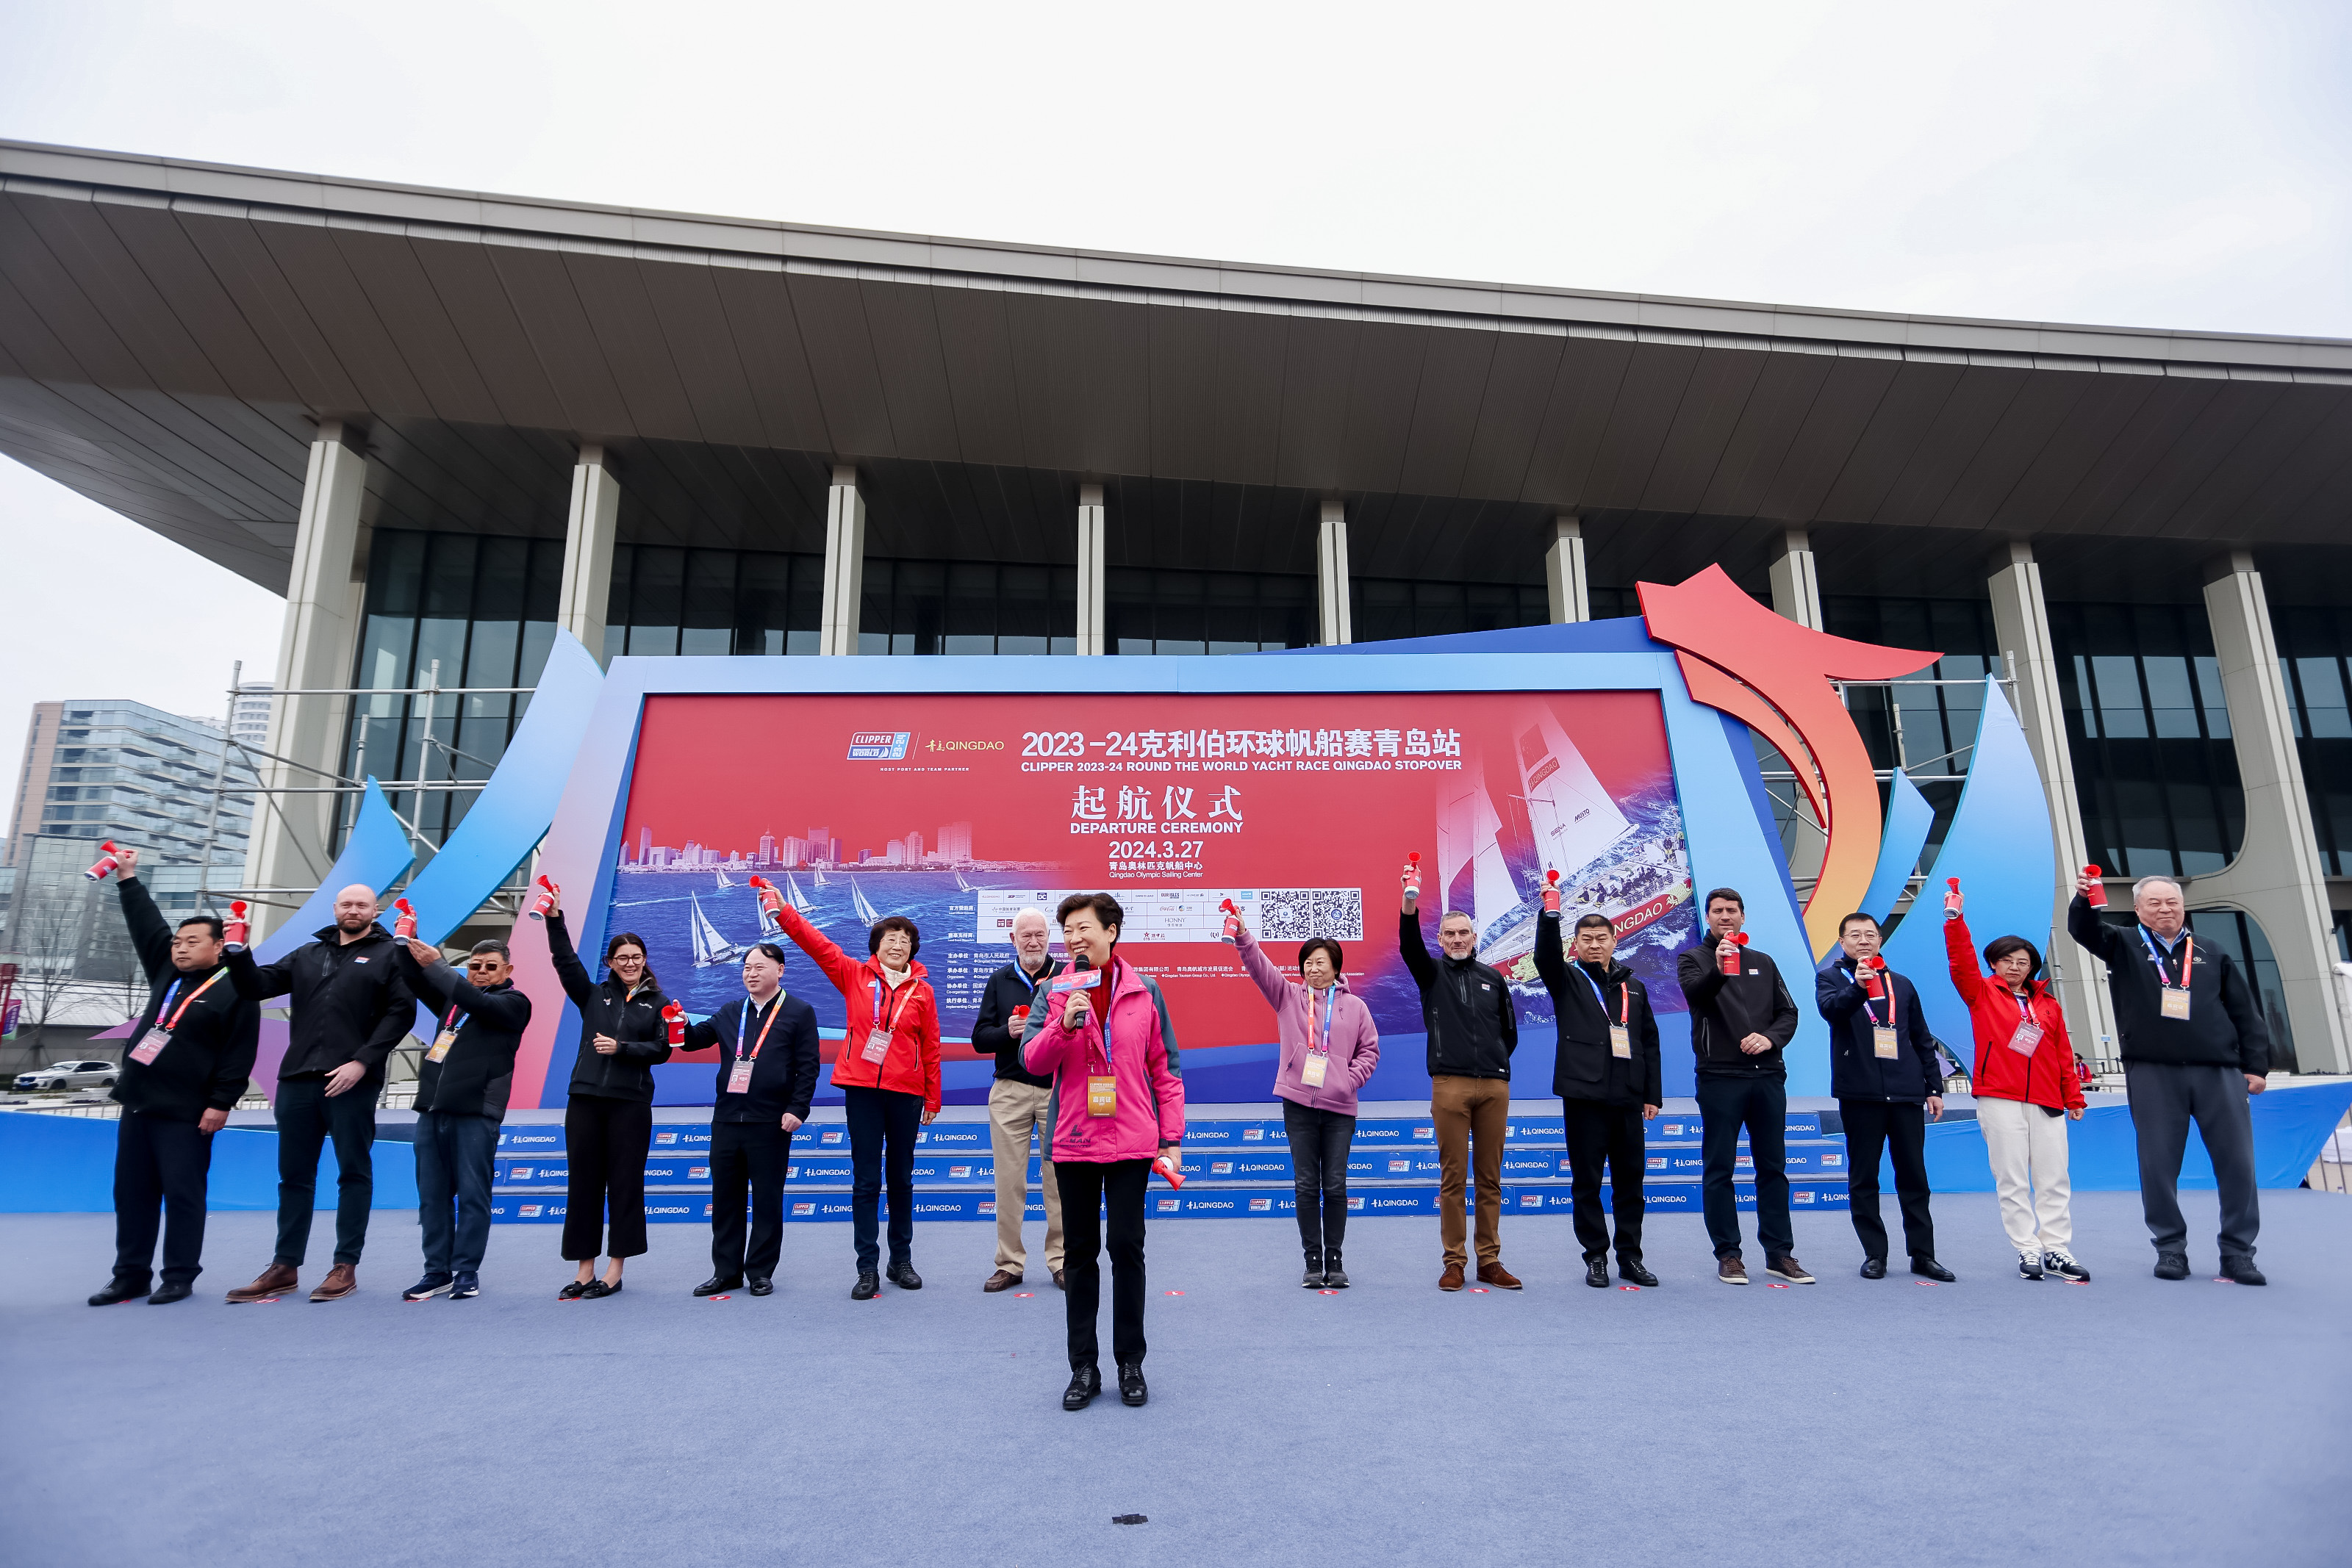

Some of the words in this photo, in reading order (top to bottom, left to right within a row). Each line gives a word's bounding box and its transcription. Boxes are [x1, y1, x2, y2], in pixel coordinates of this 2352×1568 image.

[855, 735, 892, 744] CLIPPER
[945, 741, 1005, 751] QINGDAO
[1021, 762, 1074, 772] CLIPPER
[1077, 762, 1123, 772] 2023-24
[1127, 761, 1172, 772] ROUND
[1175, 761, 1200, 772] THE
[1202, 761, 1248, 772] WORLD
[1252, 760, 1293, 771] YACHT
[1296, 760, 1330, 771] RACE
[1333, 760, 1391, 772] QINGDAO
[1394, 760, 1462, 771] STOPOVER
[1071, 785, 1243, 821] 起航仪式
[1574, 808, 1590, 822] MUSTO
[1070, 822, 1157, 834] DEPARTURE
[1161, 821, 1244, 834] CEREMONY
[1108, 841, 1204, 859] 2024.3.27
[1108, 861, 1203, 871] 青岛奥林匹克帆船中心
[1161, 871, 1182, 879] Sailing
[1613, 902, 1663, 936] NGDAO
